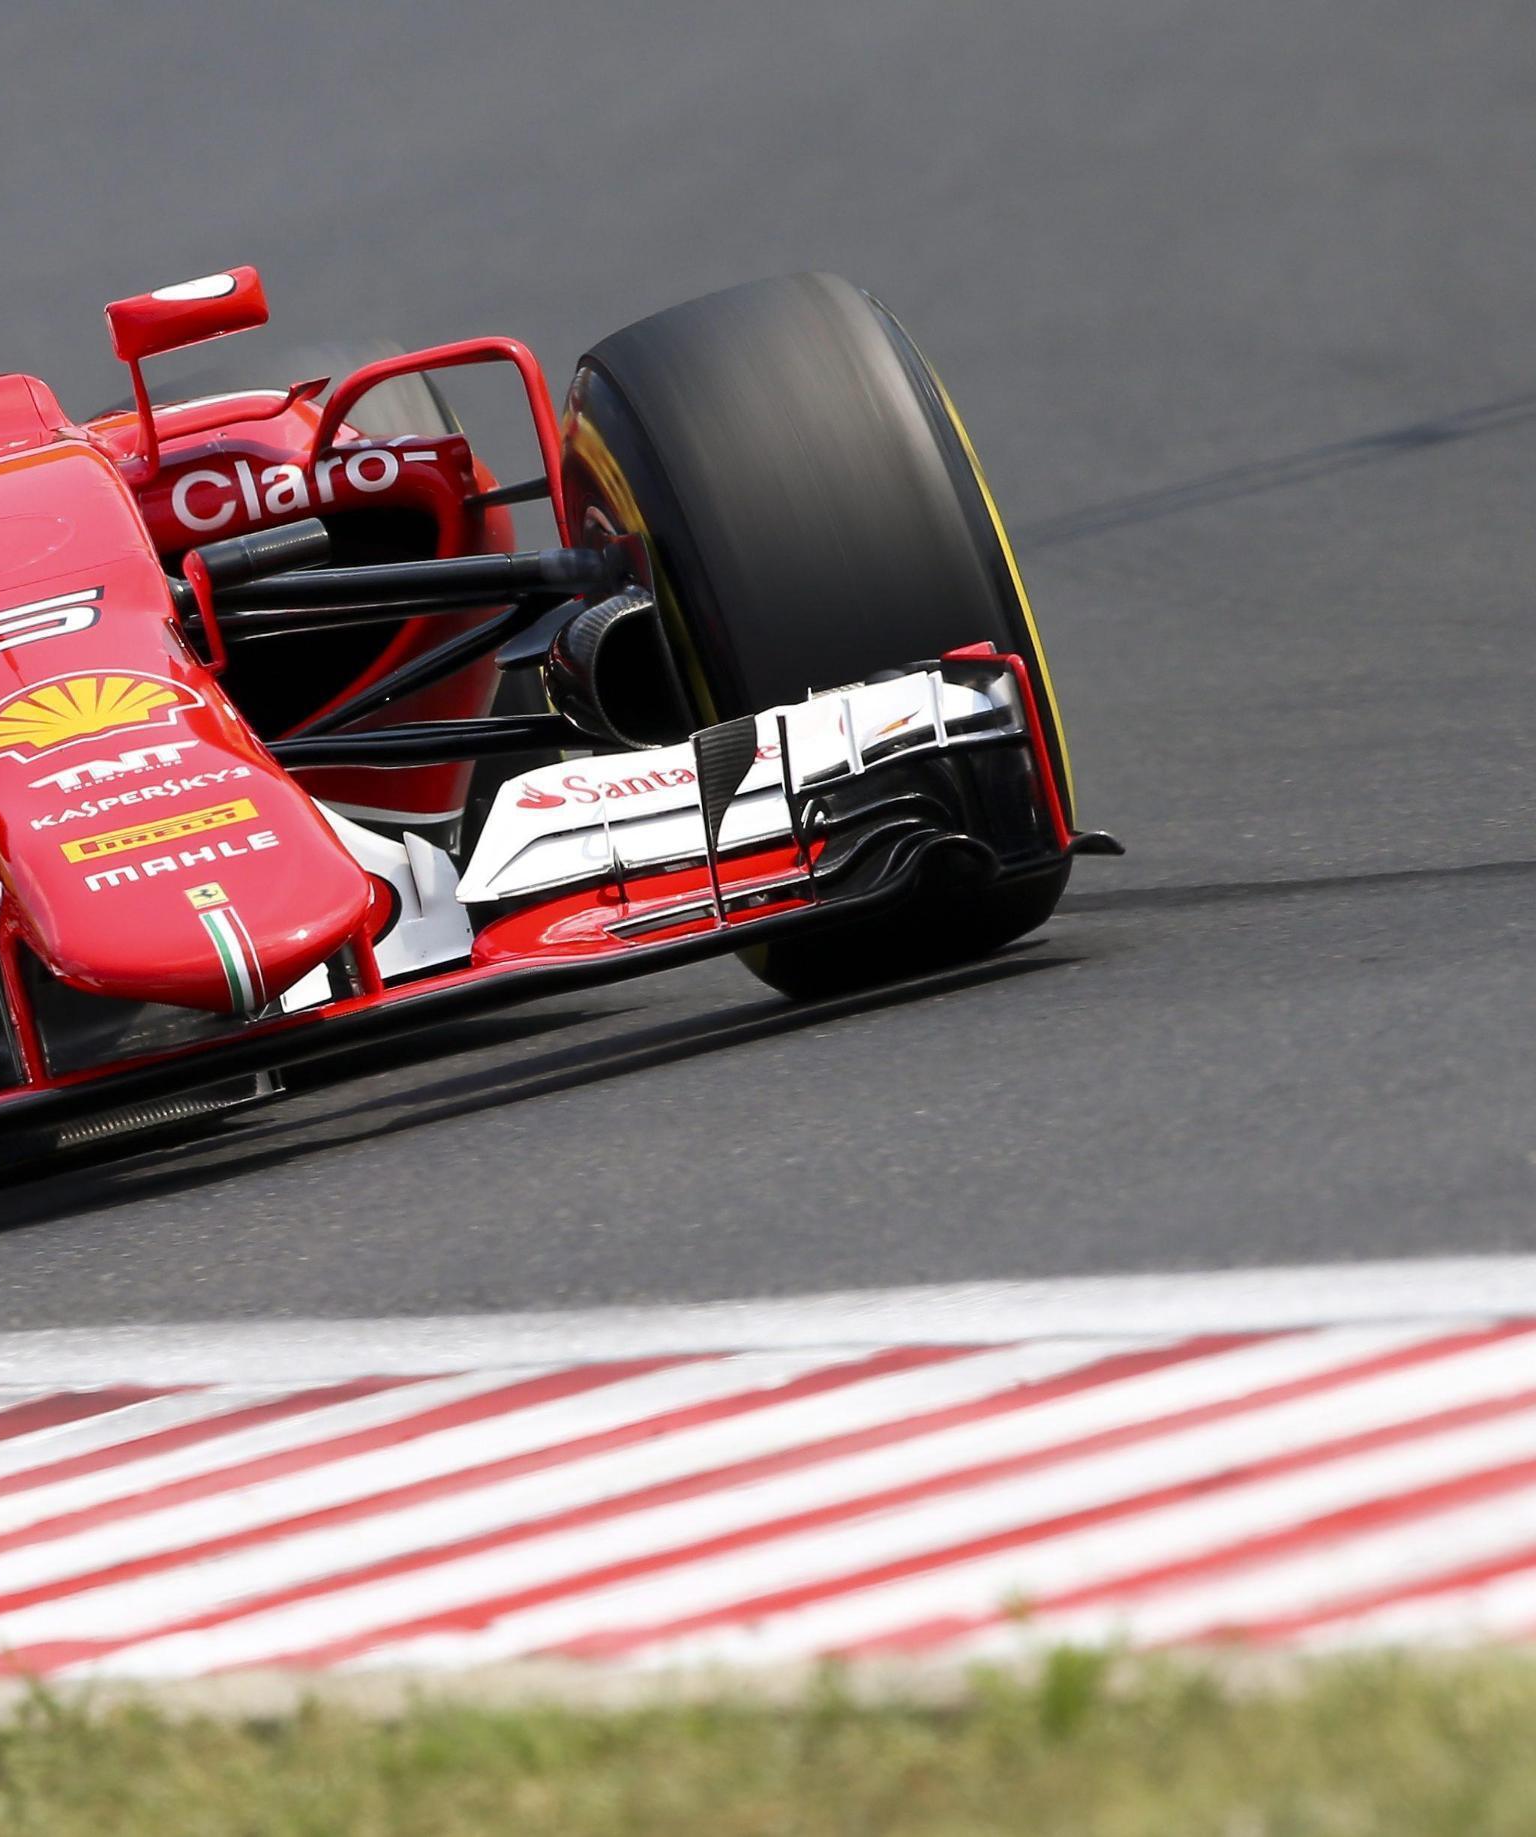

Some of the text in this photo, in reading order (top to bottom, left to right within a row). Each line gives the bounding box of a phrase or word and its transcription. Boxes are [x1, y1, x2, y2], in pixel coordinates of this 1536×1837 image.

[27, 739, 200, 791] TNT
[29, 769, 229, 831] KASPERSKY
[78, 807, 238, 855] PIRELLI
[83, 830, 280, 892] MAHLE
